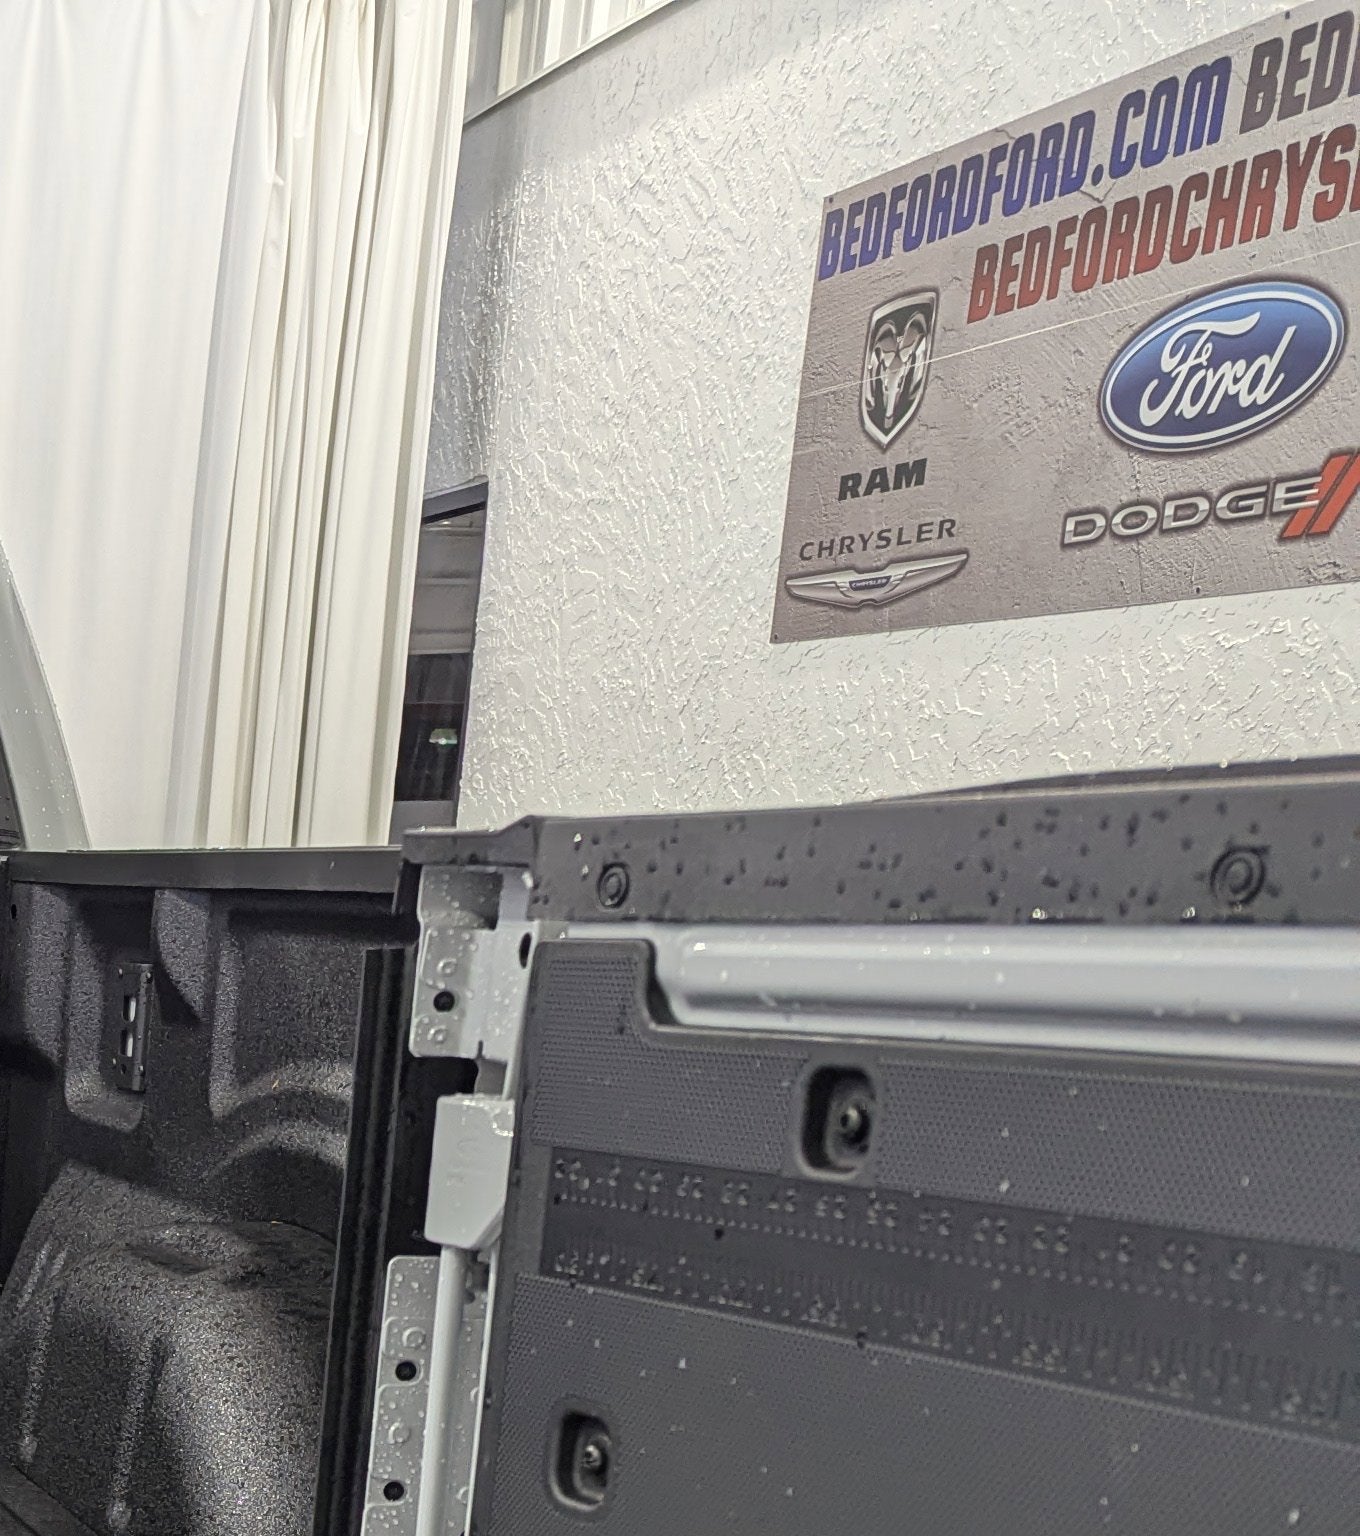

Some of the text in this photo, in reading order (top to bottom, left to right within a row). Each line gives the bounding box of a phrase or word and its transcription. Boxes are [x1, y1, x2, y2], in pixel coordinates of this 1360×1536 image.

[818, 55, 1232, 281] BEDFORDFORD.COM
[1139, 311, 1298, 428] Ford
[837, 457, 928, 501] RAM
[1062, 475, 1323, 546] DODGE
[798, 517, 957, 562] CHRYSLER
